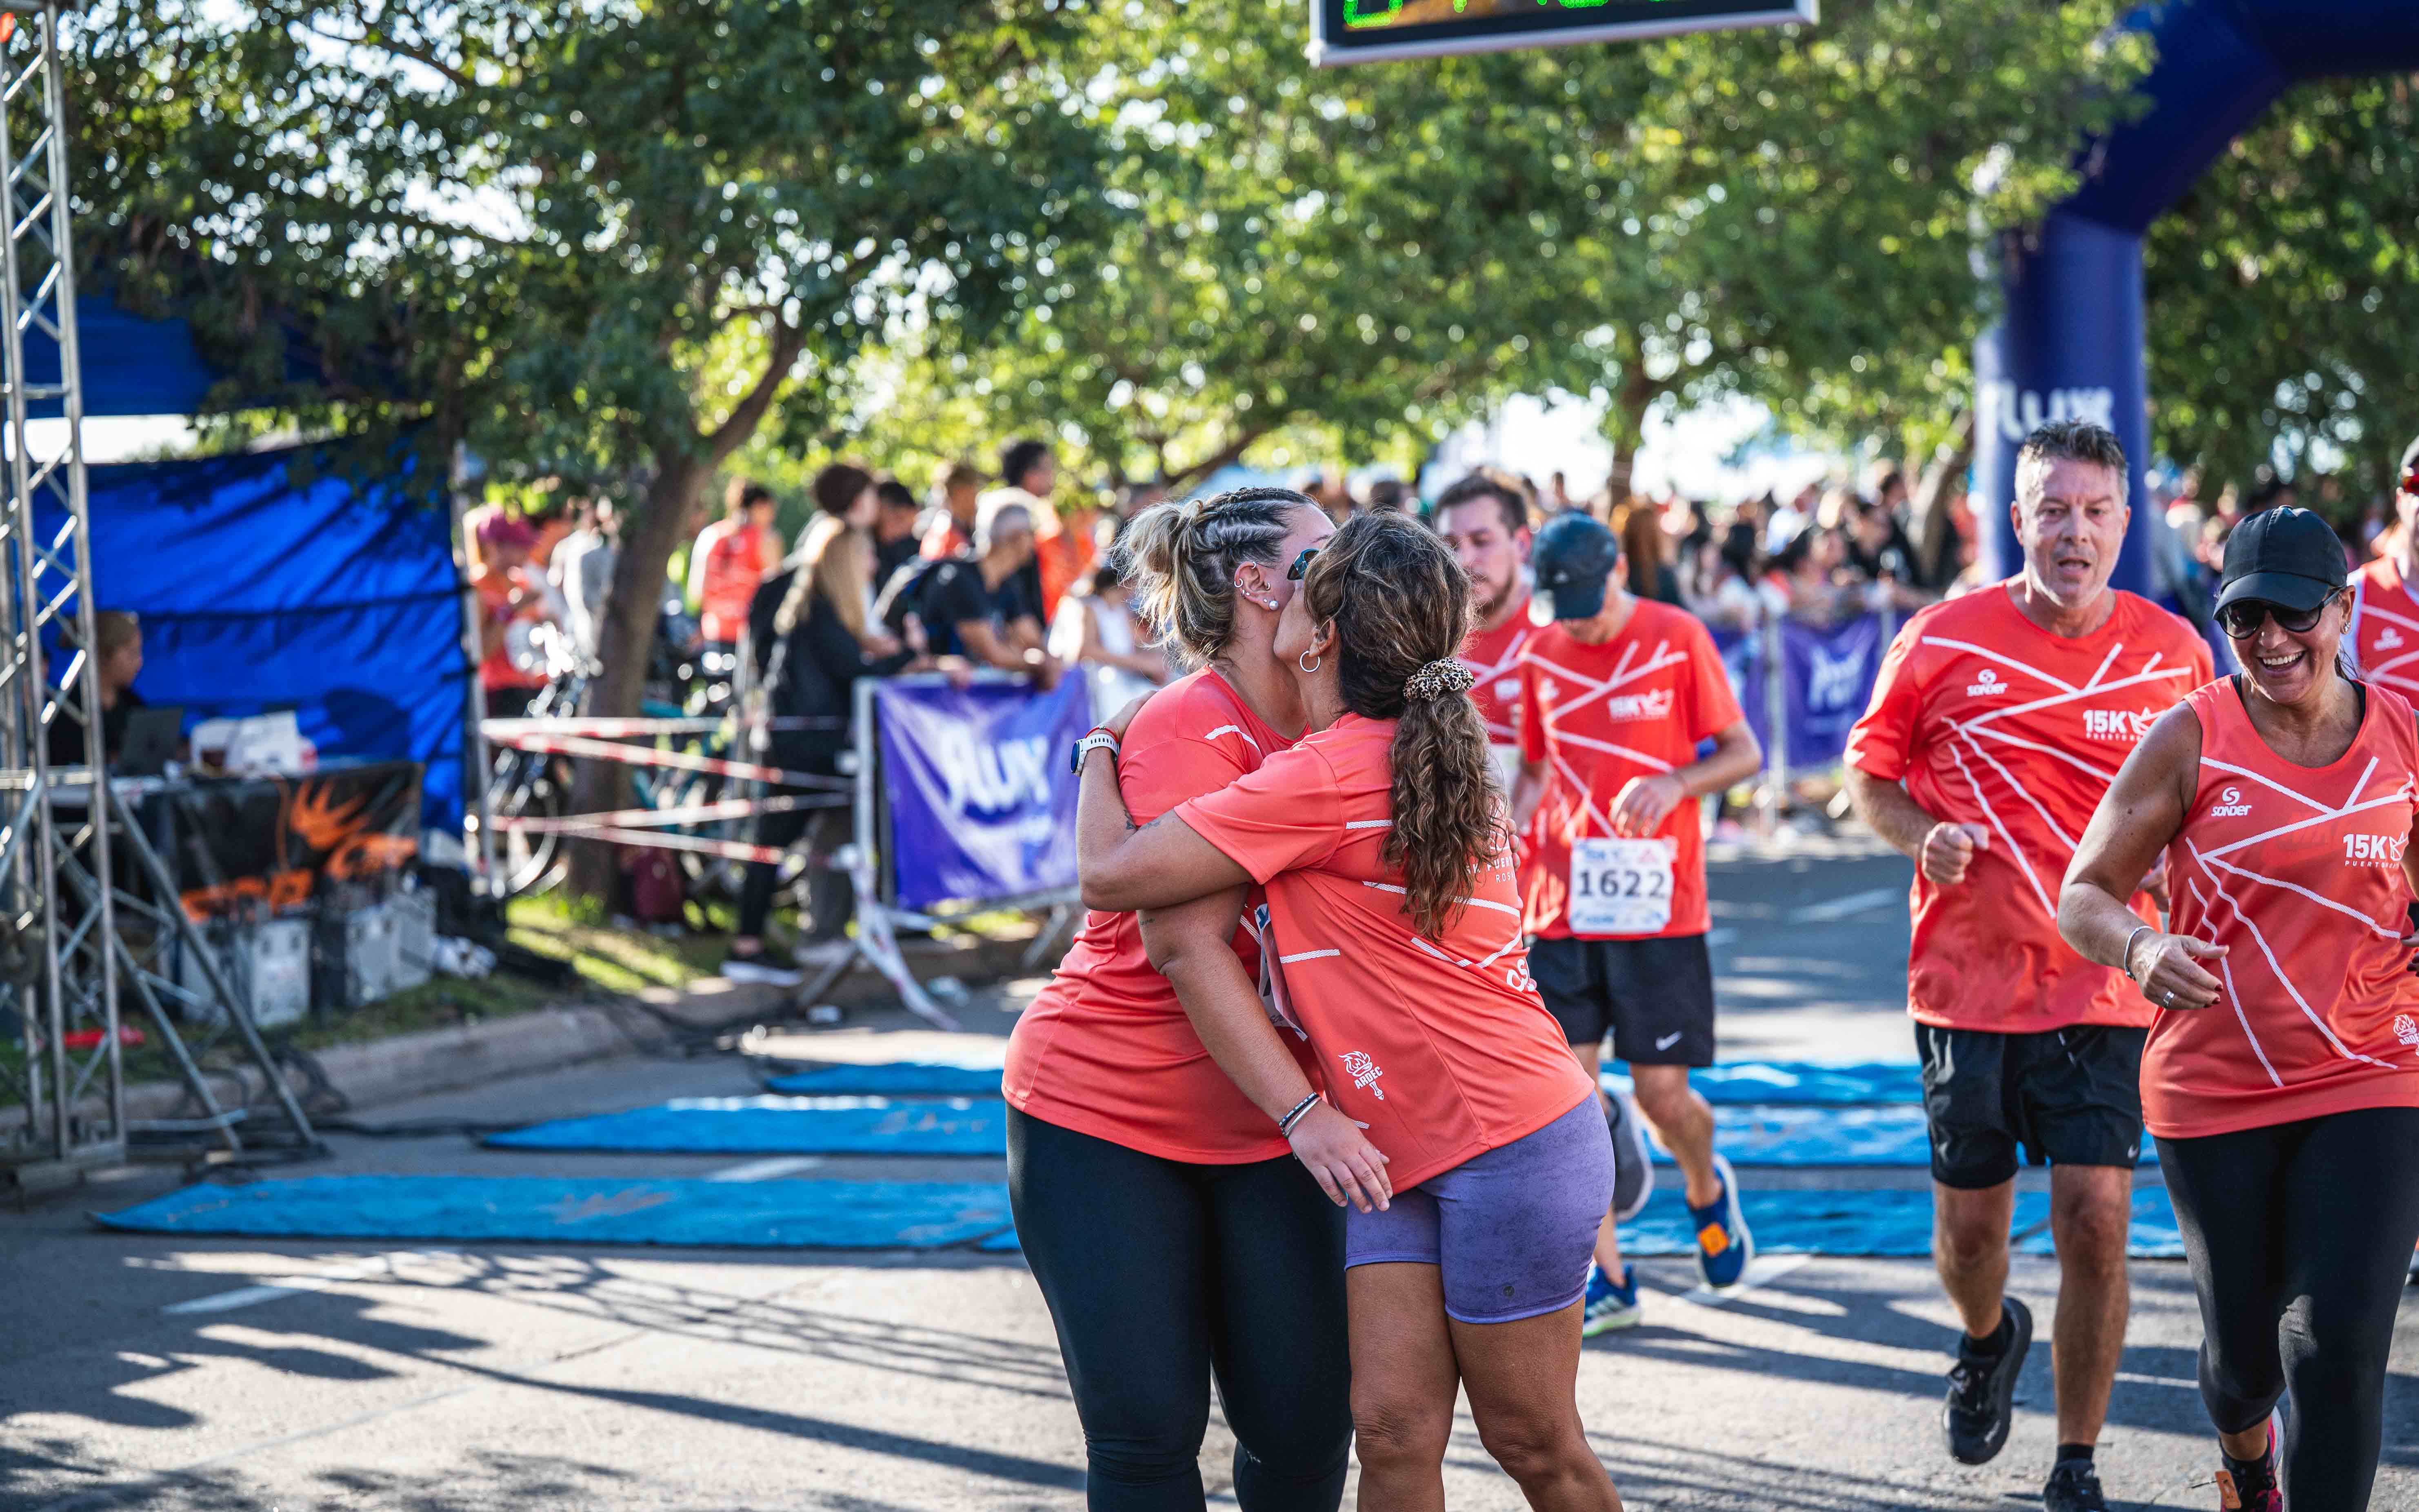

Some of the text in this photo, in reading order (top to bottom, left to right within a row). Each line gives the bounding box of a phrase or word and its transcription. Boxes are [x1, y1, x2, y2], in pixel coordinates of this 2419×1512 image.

[2083, 710, 2128, 734] 15K
[2343, 834, 2388, 859] 15K
[1578, 870, 1666, 898] 1622
[1354, 1066, 1383, 1090] ARDEC
